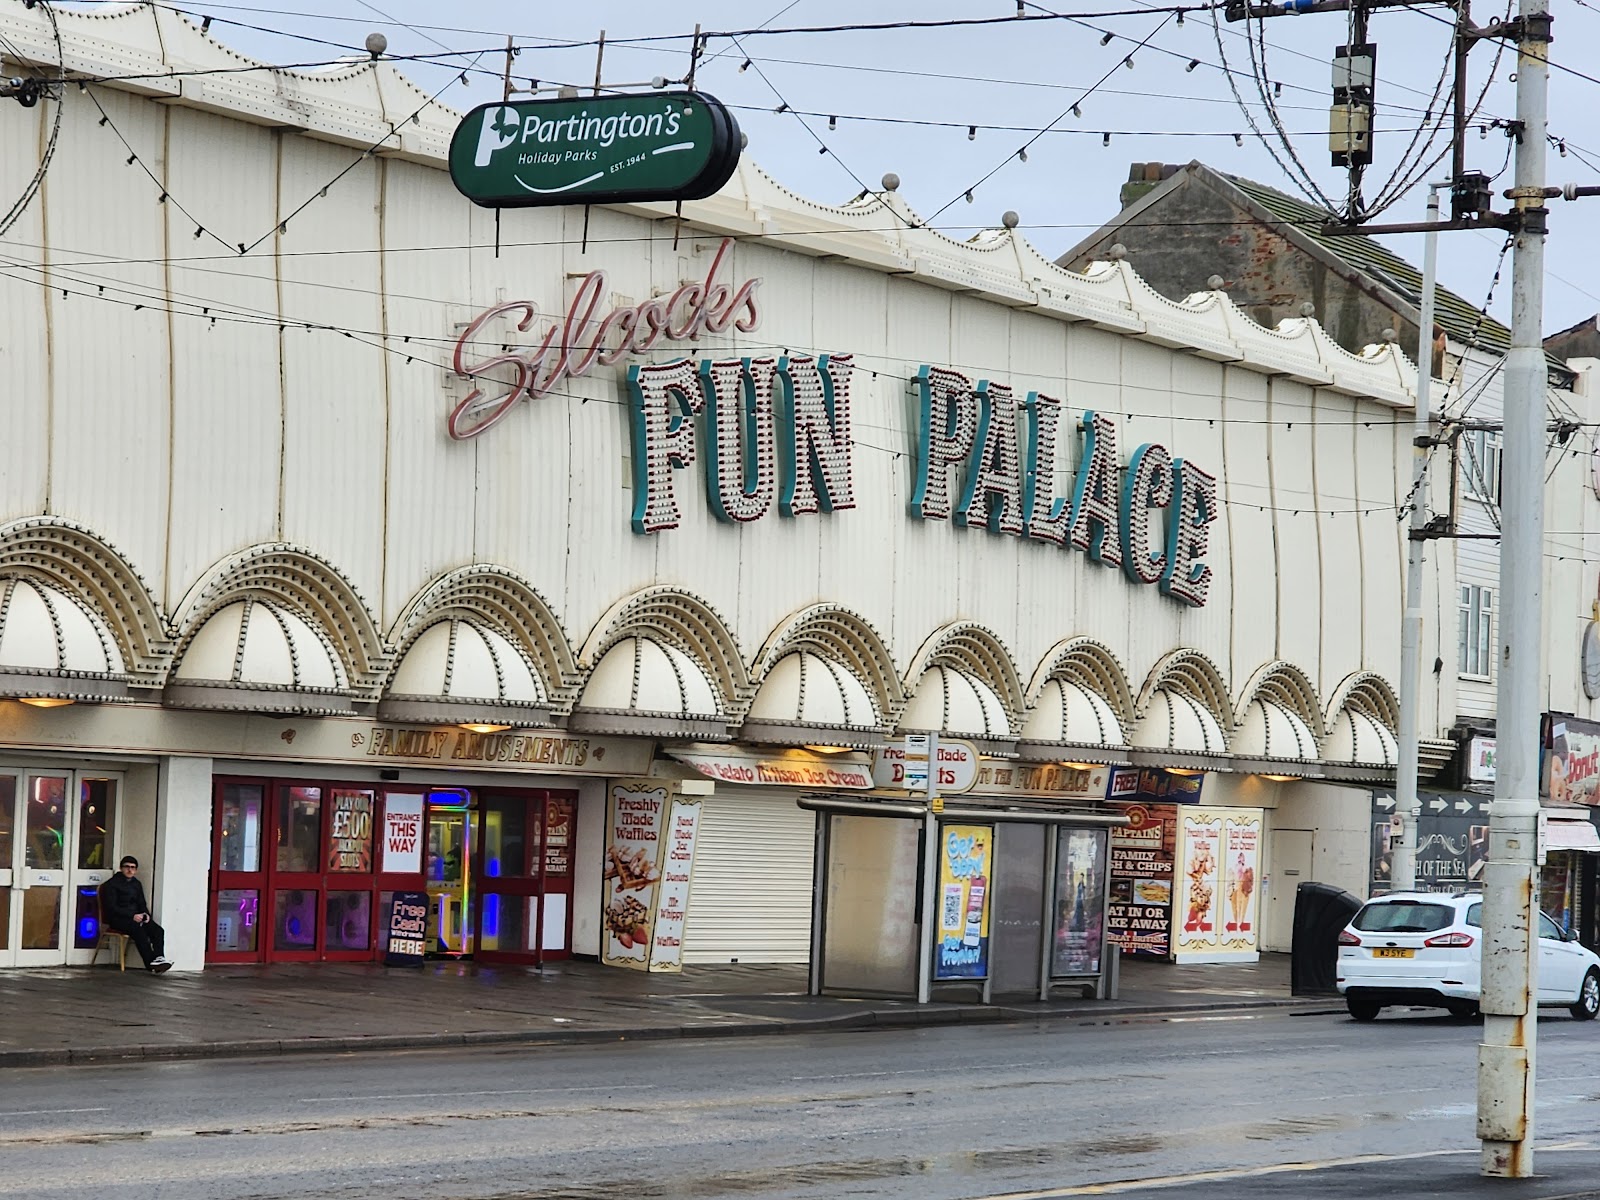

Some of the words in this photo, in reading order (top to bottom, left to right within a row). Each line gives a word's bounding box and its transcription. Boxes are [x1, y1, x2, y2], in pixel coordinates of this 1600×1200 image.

[521, 104, 681, 147] Partington's
[518, 151, 562, 165] Holiday
[565, 150, 597, 163] Parks
[610, 161, 625, 174] EST.
[626, 152, 646, 167] 1944
[626, 353, 857, 535] FUN
[910, 364, 1219, 608] PALACE
[367, 727, 448, 758] FAMILY
[451, 732, 590, 766] AMUSEMENTS
[714, 761, 754, 782] Gelato
[755, 764, 805, 783] Artisan
[803, 767, 826, 784] Ice
[826, 768, 868, 787] Cream
[994, 768, 1013, 785] THE
[1015, 766, 1043, 790] FUN
[1044, 767, 1092, 792] PALACE
[1113, 773, 1138, 792] FREE
[618, 797, 660, 814] Freshly
[332, 810, 370, 840] £500
[387, 813, 420, 822] ENTRANCE
[621, 812, 654, 826] Made
[390, 822, 417, 837] THIS
[615, 827, 657, 841] Waffles
[389, 838, 417, 853] WAY
[1113, 850, 1156, 860] FAMILY
[1137, 861, 1172, 872] CHIPS
[1423, 860, 1434, 876] OF
[1436, 860, 1452, 876] THE
[393, 900, 426, 917] Free
[1108, 906, 1125, 916] AT
[1128, 907, 1143, 917] IN
[1145, 908, 1164, 918] OR
[391, 914, 425, 932] Cash
[1130, 919, 1169, 930] AWAY
[389, 938, 425, 956] HERE
